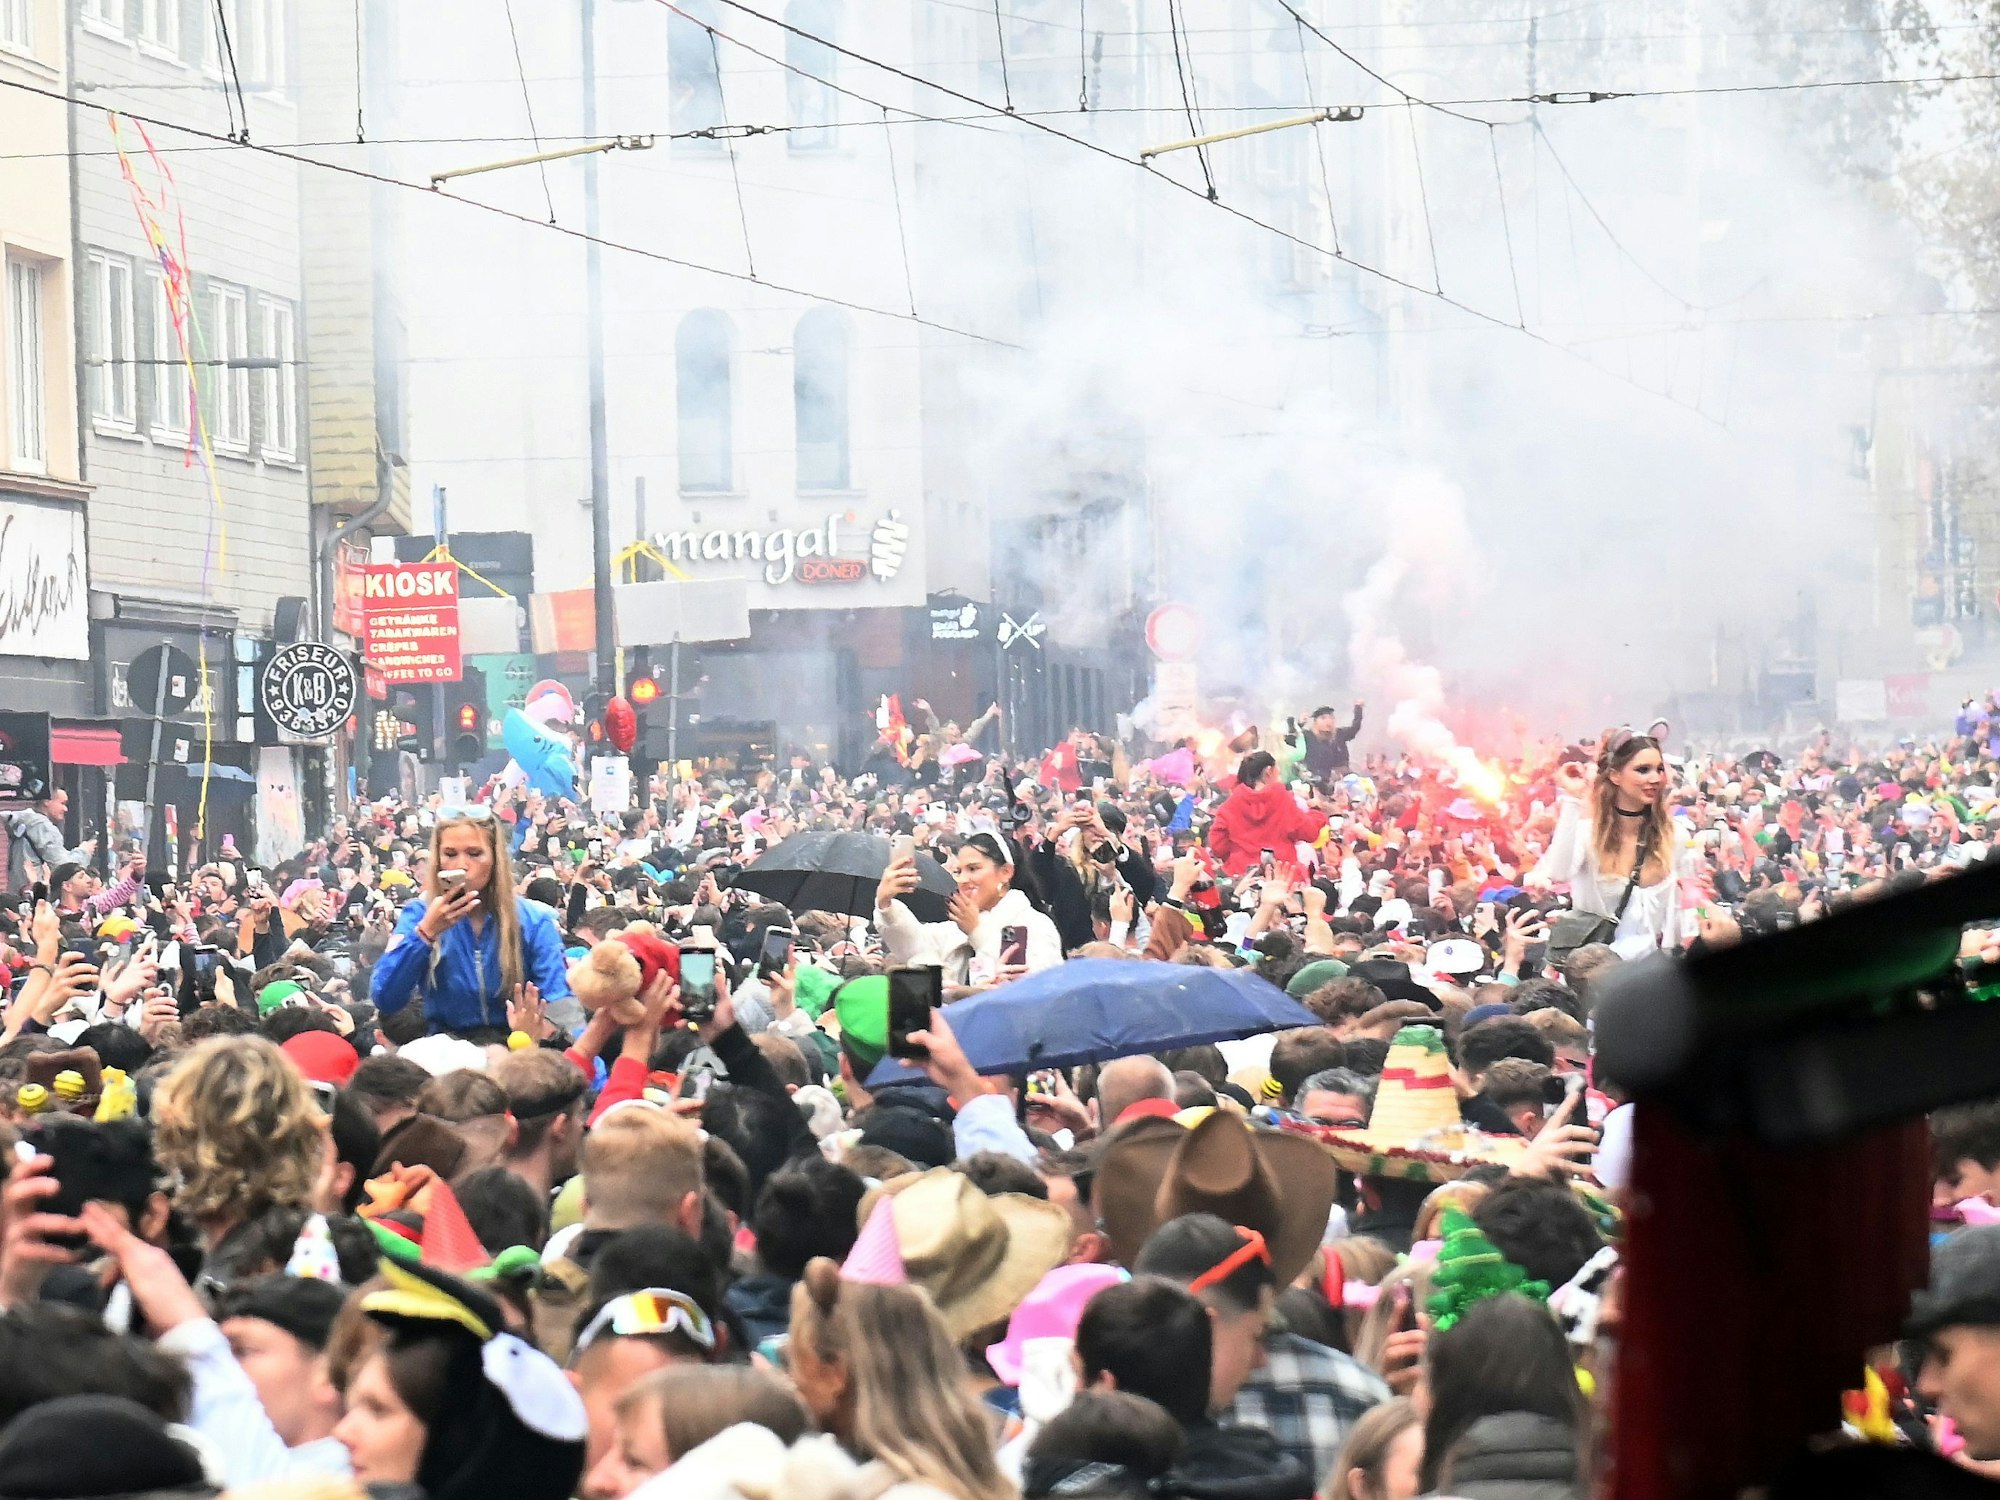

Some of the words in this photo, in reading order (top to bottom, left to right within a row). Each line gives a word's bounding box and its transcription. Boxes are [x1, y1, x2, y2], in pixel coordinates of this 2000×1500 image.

[655, 513, 846, 584] mangal
[364, 570, 455, 598] KIOSK
[369, 626, 457, 639] TABAKWAREN
[268, 645, 349, 682] FRISEUR
[383, 669, 415, 679] FFEE
[417, 667, 433, 677] TO
[435, 666, 453, 677] GO
[292, 672, 326, 706] K&B
